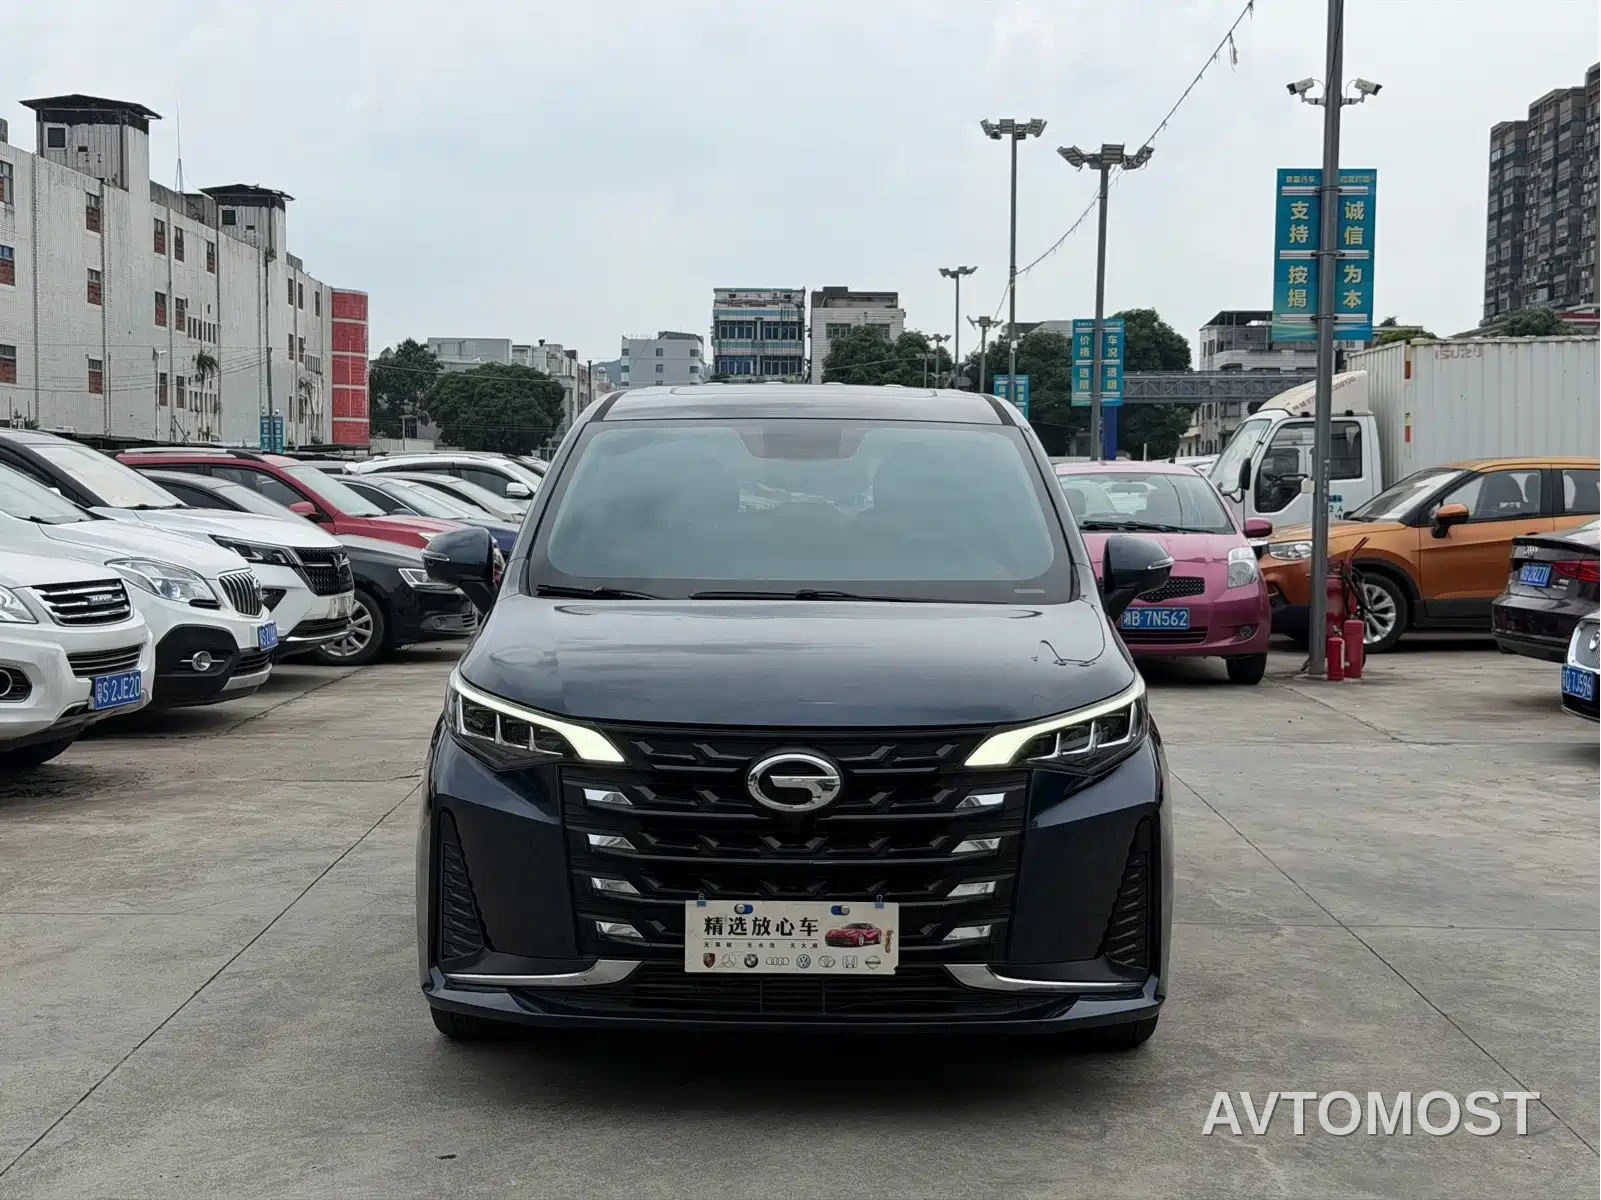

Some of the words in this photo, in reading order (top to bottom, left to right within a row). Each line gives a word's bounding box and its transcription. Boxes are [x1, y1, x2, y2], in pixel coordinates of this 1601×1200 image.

[1287, 201, 1310, 308] 支持按揭
[1342, 200, 1365, 309] 诚信为本
[703, 916, 819, 936] 精选放心车
